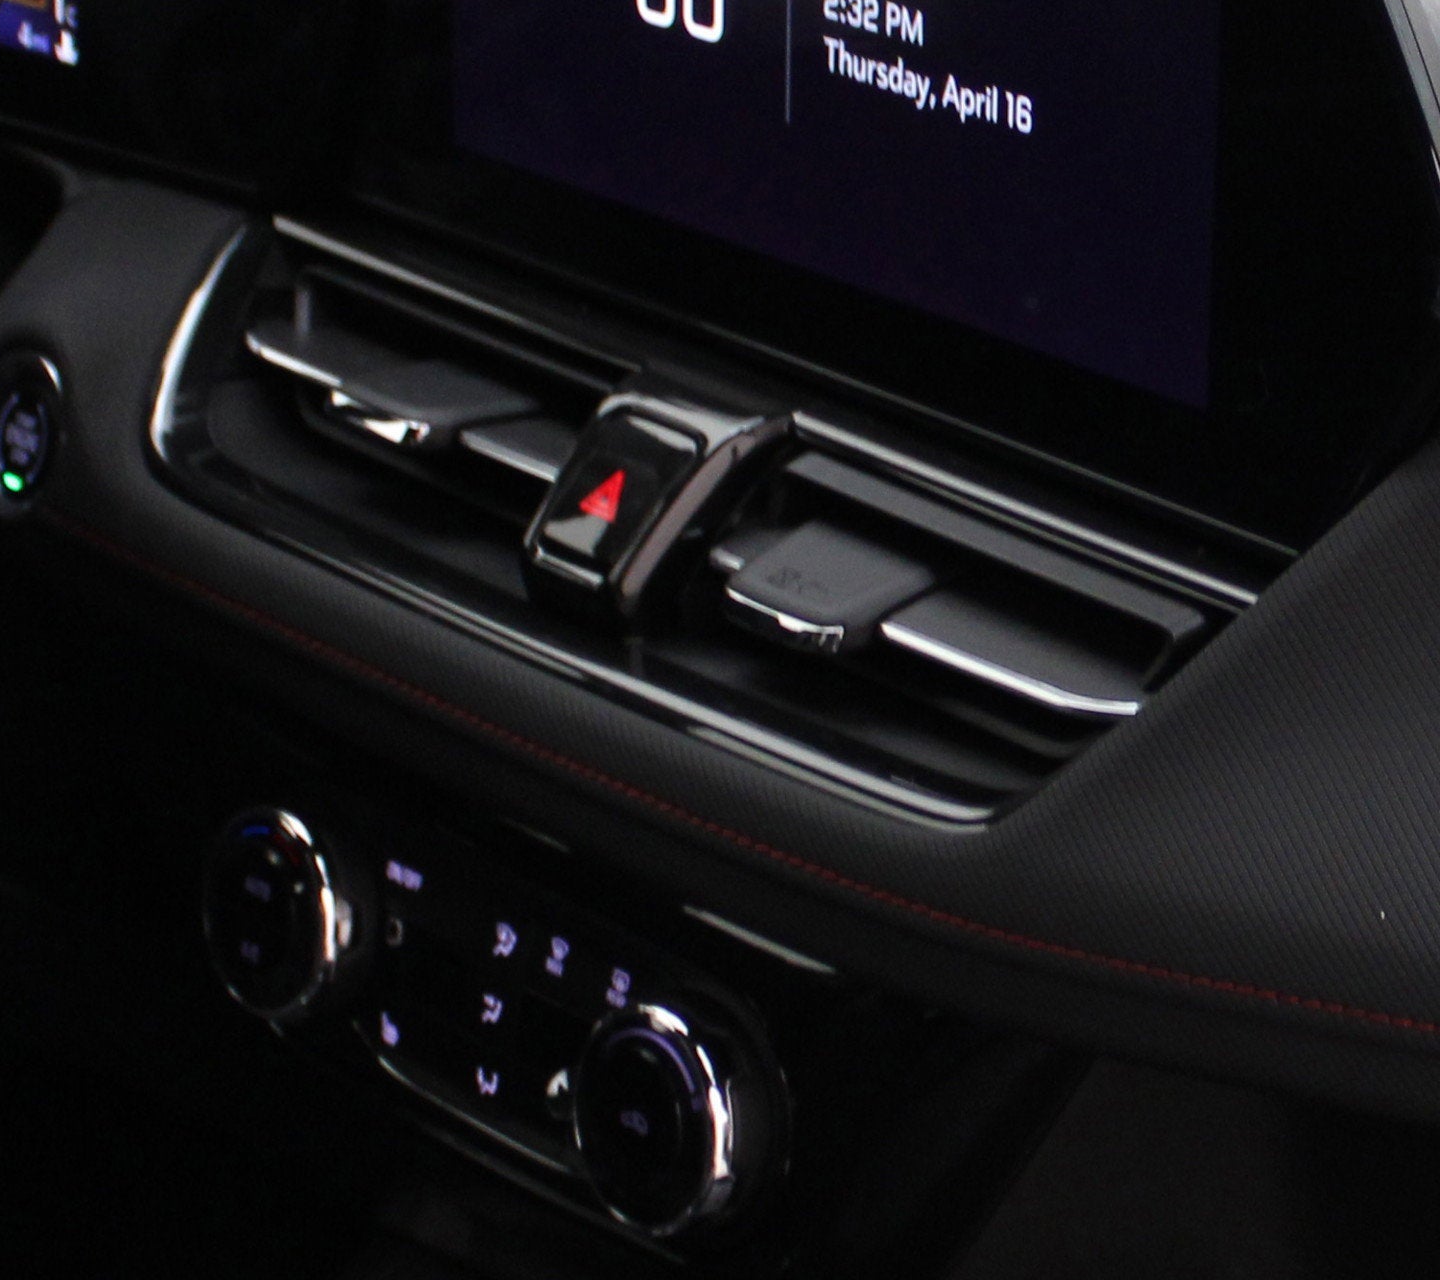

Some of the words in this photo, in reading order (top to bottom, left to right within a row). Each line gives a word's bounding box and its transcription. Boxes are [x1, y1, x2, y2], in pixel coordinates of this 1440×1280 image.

[885, 0, 924, 47] PM
[823, 35, 937, 111] Thursday,
[941, 76, 999, 123] April
[1005, 90, 1033, 134] 16
